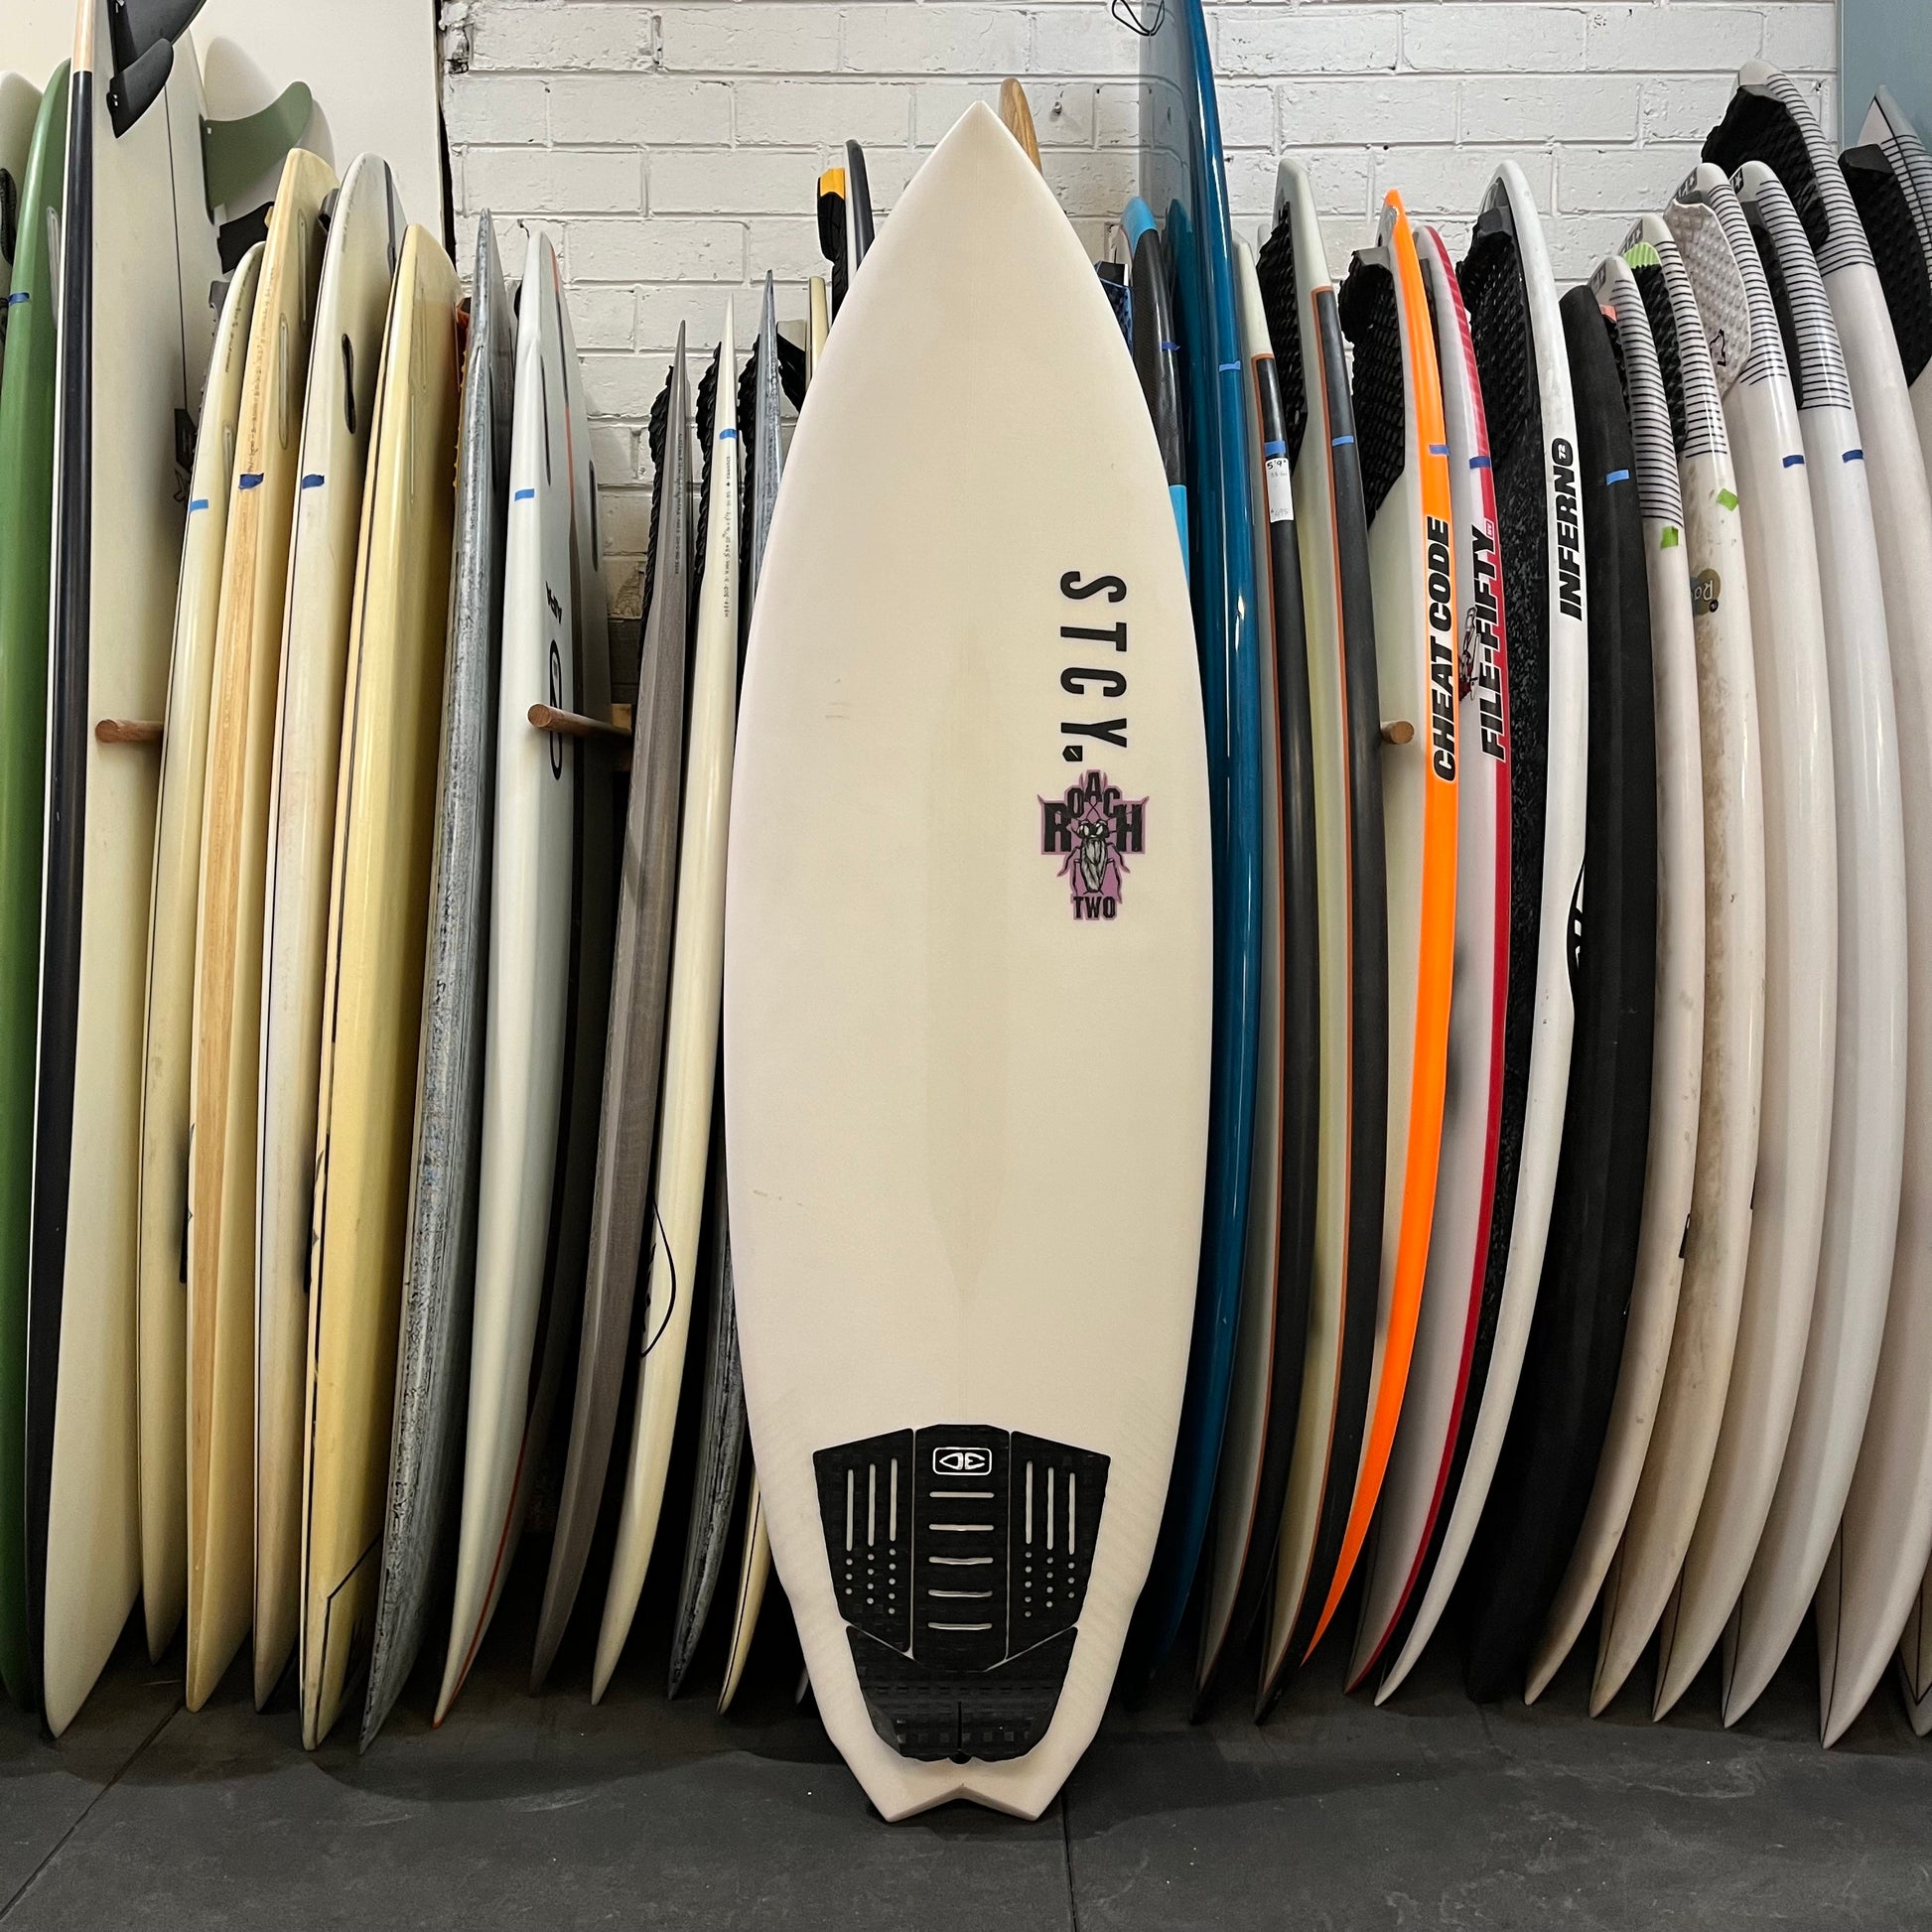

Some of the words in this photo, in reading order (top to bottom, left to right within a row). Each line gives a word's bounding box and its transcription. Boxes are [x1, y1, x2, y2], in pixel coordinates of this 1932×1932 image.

[1558, 444, 1568, 460] 72
[1427, 516, 1453, 632] CODE
[1551, 437, 1583, 622] INFERNO
[1471, 523, 1506, 762] FILE-FIFTY
[1430, 635, 1456, 781] CHEAT
[1043, 771, 1143, 853] ROACH
[1073, 896, 1117, 918] TWO
